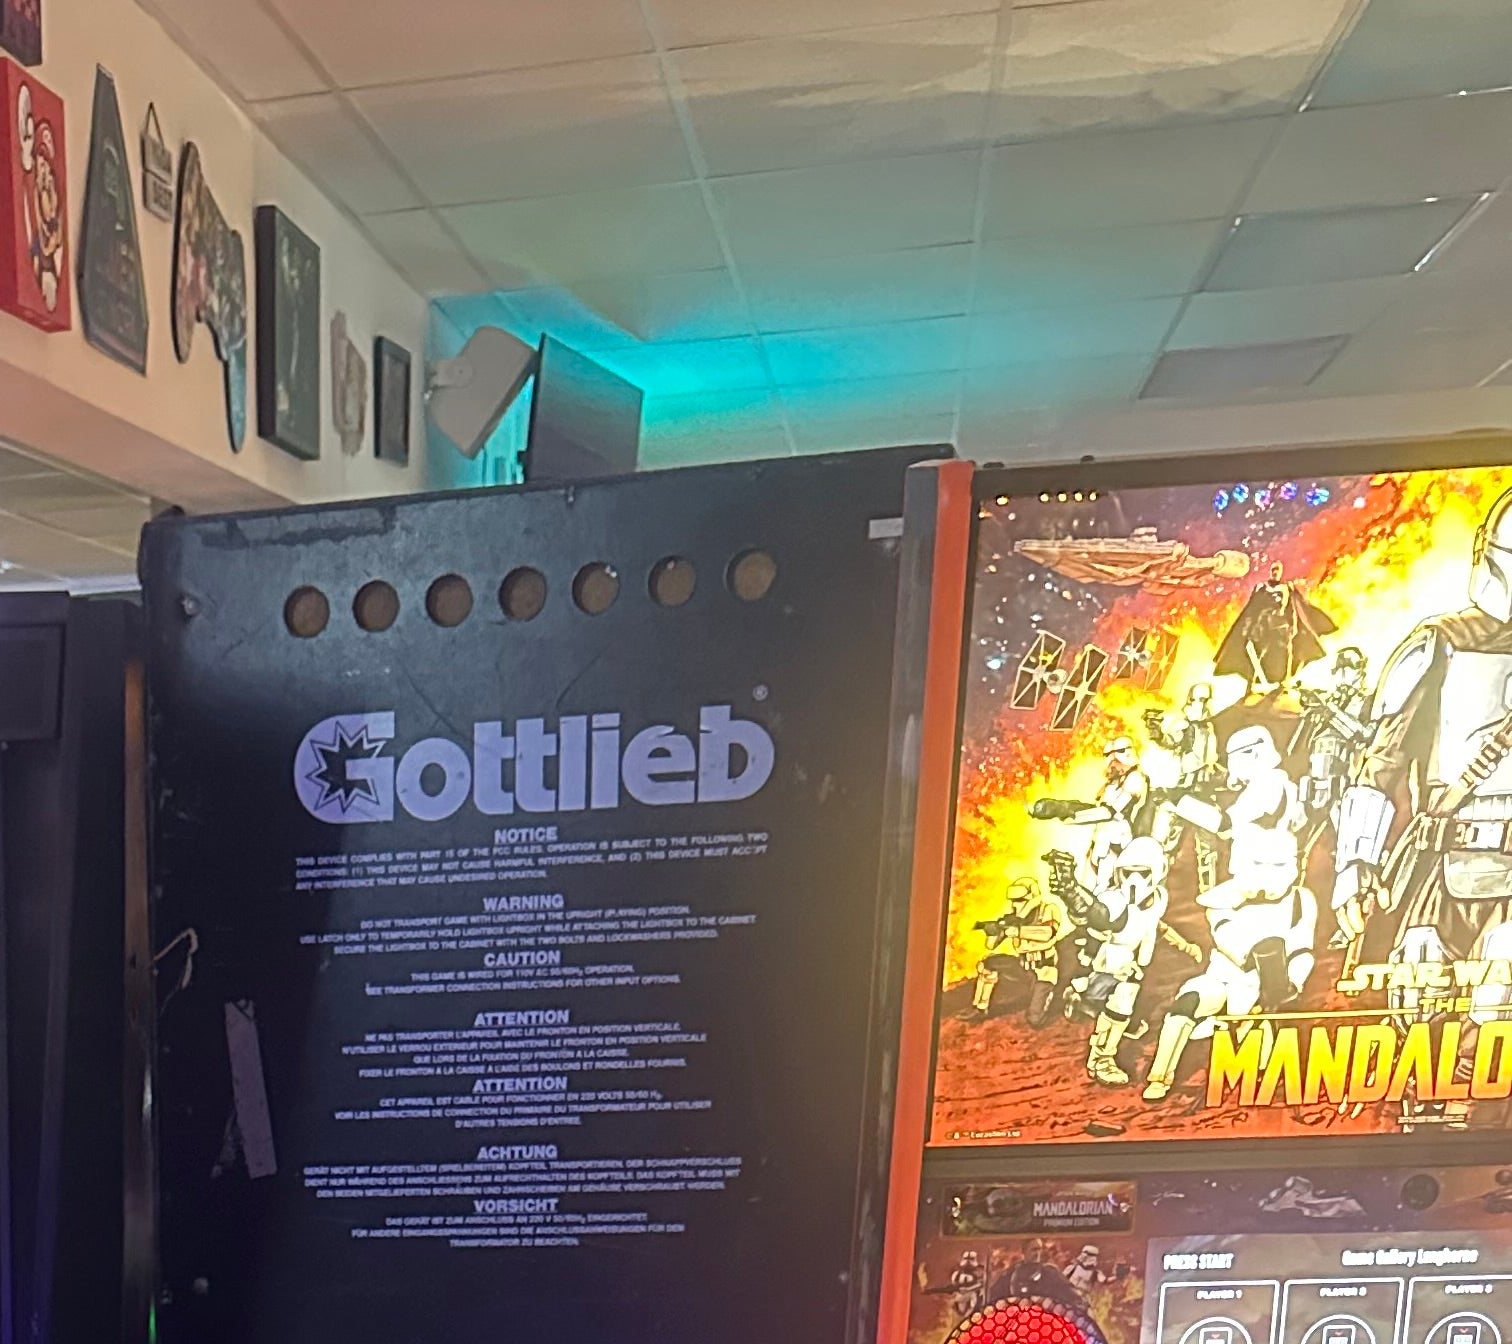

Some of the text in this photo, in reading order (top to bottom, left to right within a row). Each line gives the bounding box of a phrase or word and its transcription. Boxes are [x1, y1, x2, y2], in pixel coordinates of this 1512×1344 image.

[294, 705, 775, 824] Gottlieb
[494, 826, 558, 844] NOTICE
[483, 894, 564, 911] WARNING
[484, 950, 561, 967] CAUTION
[1337, 962, 1451, 992] STAR
[1419, 997, 1471, 1013] THE
[474, 1009, 569, 1026] ATTENTION
[472, 1076, 567, 1093] ATTENTION
[477, 1145, 557, 1160] ACHTUNG
[474, 1198, 558, 1213] VORSICHT
[1033, 1201, 1113, 1217] MANDALORIAN
[1198, 1253, 1234, 1269] START
